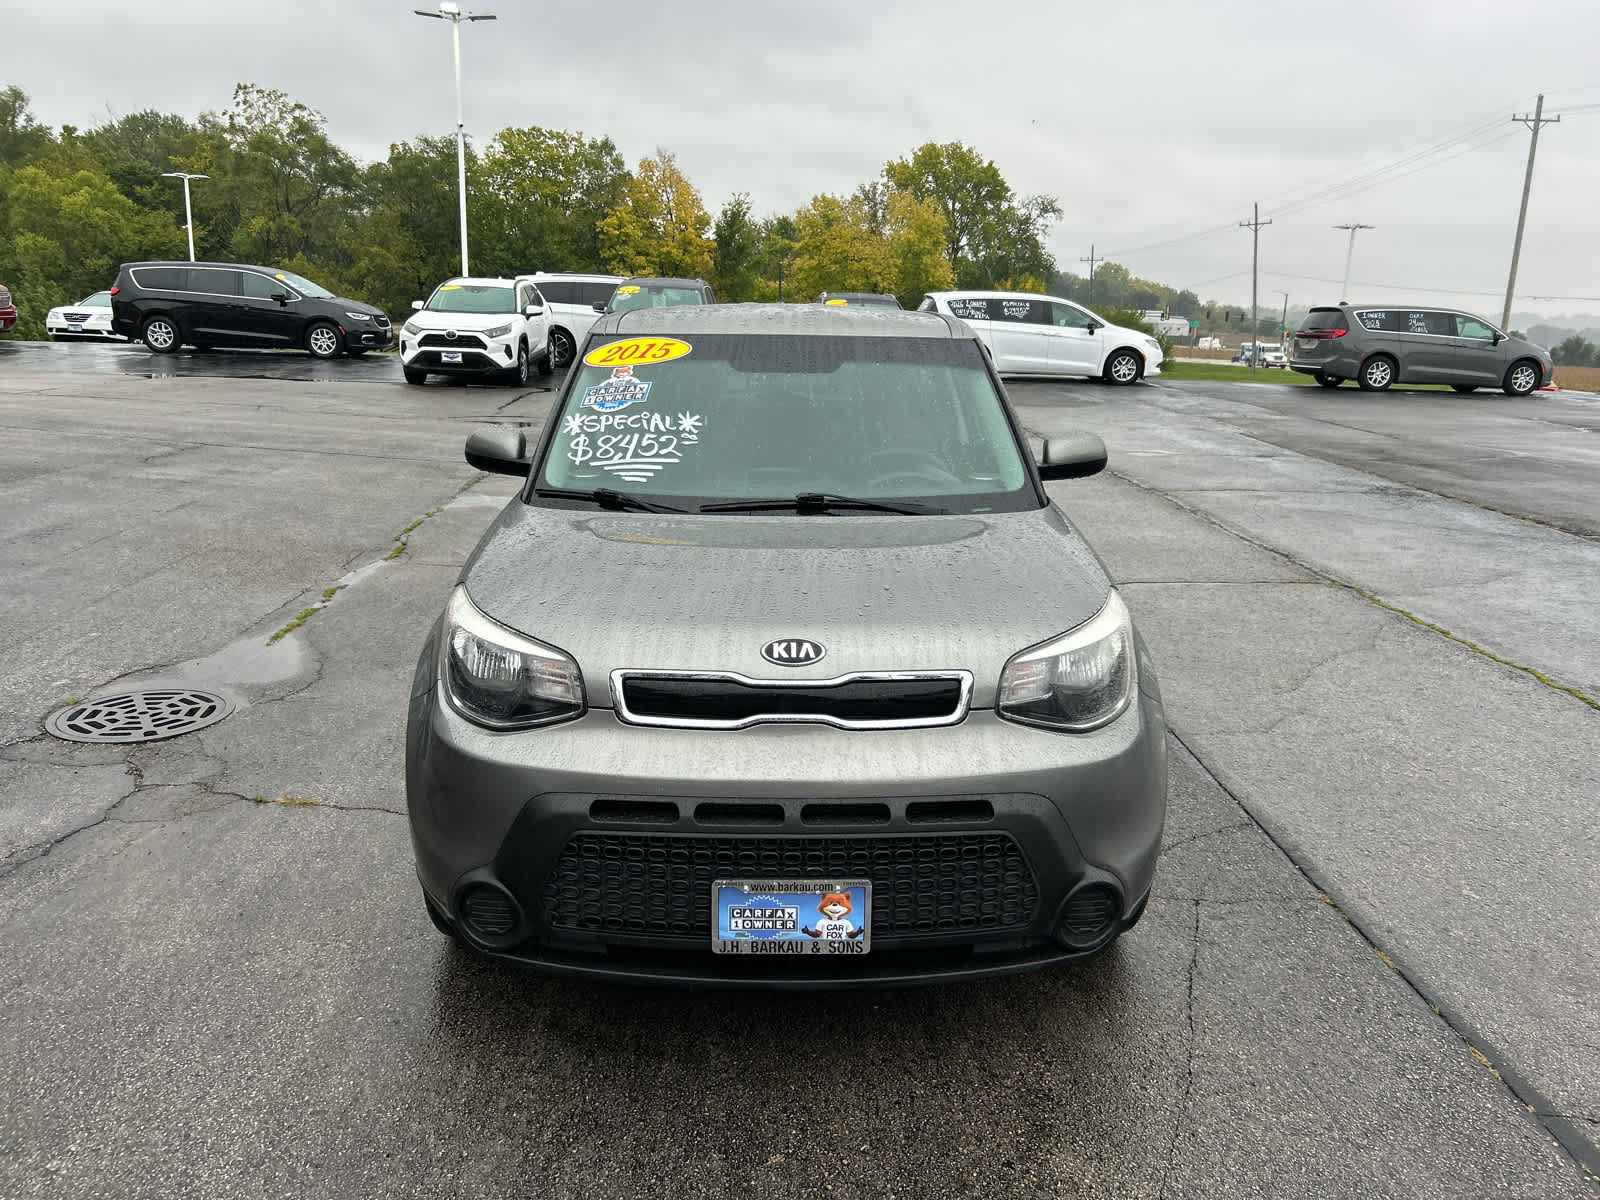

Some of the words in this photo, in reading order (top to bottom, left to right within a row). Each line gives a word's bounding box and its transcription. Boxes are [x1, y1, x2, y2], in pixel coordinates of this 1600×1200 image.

[599, 343, 676, 363] 2015
[589, 384, 647, 396] CARFAX
[772, 642, 816, 659] KIA
[750, 882, 833, 893] www.barkau.com
[732, 908, 796, 919] CARFAX
[826, 923, 844, 931] CAR
[719, 941, 743, 953] J.H.
[750, 941, 803, 953] BARKAU
[811, 941, 821, 953] &
[828, 941, 864, 954] SONS
